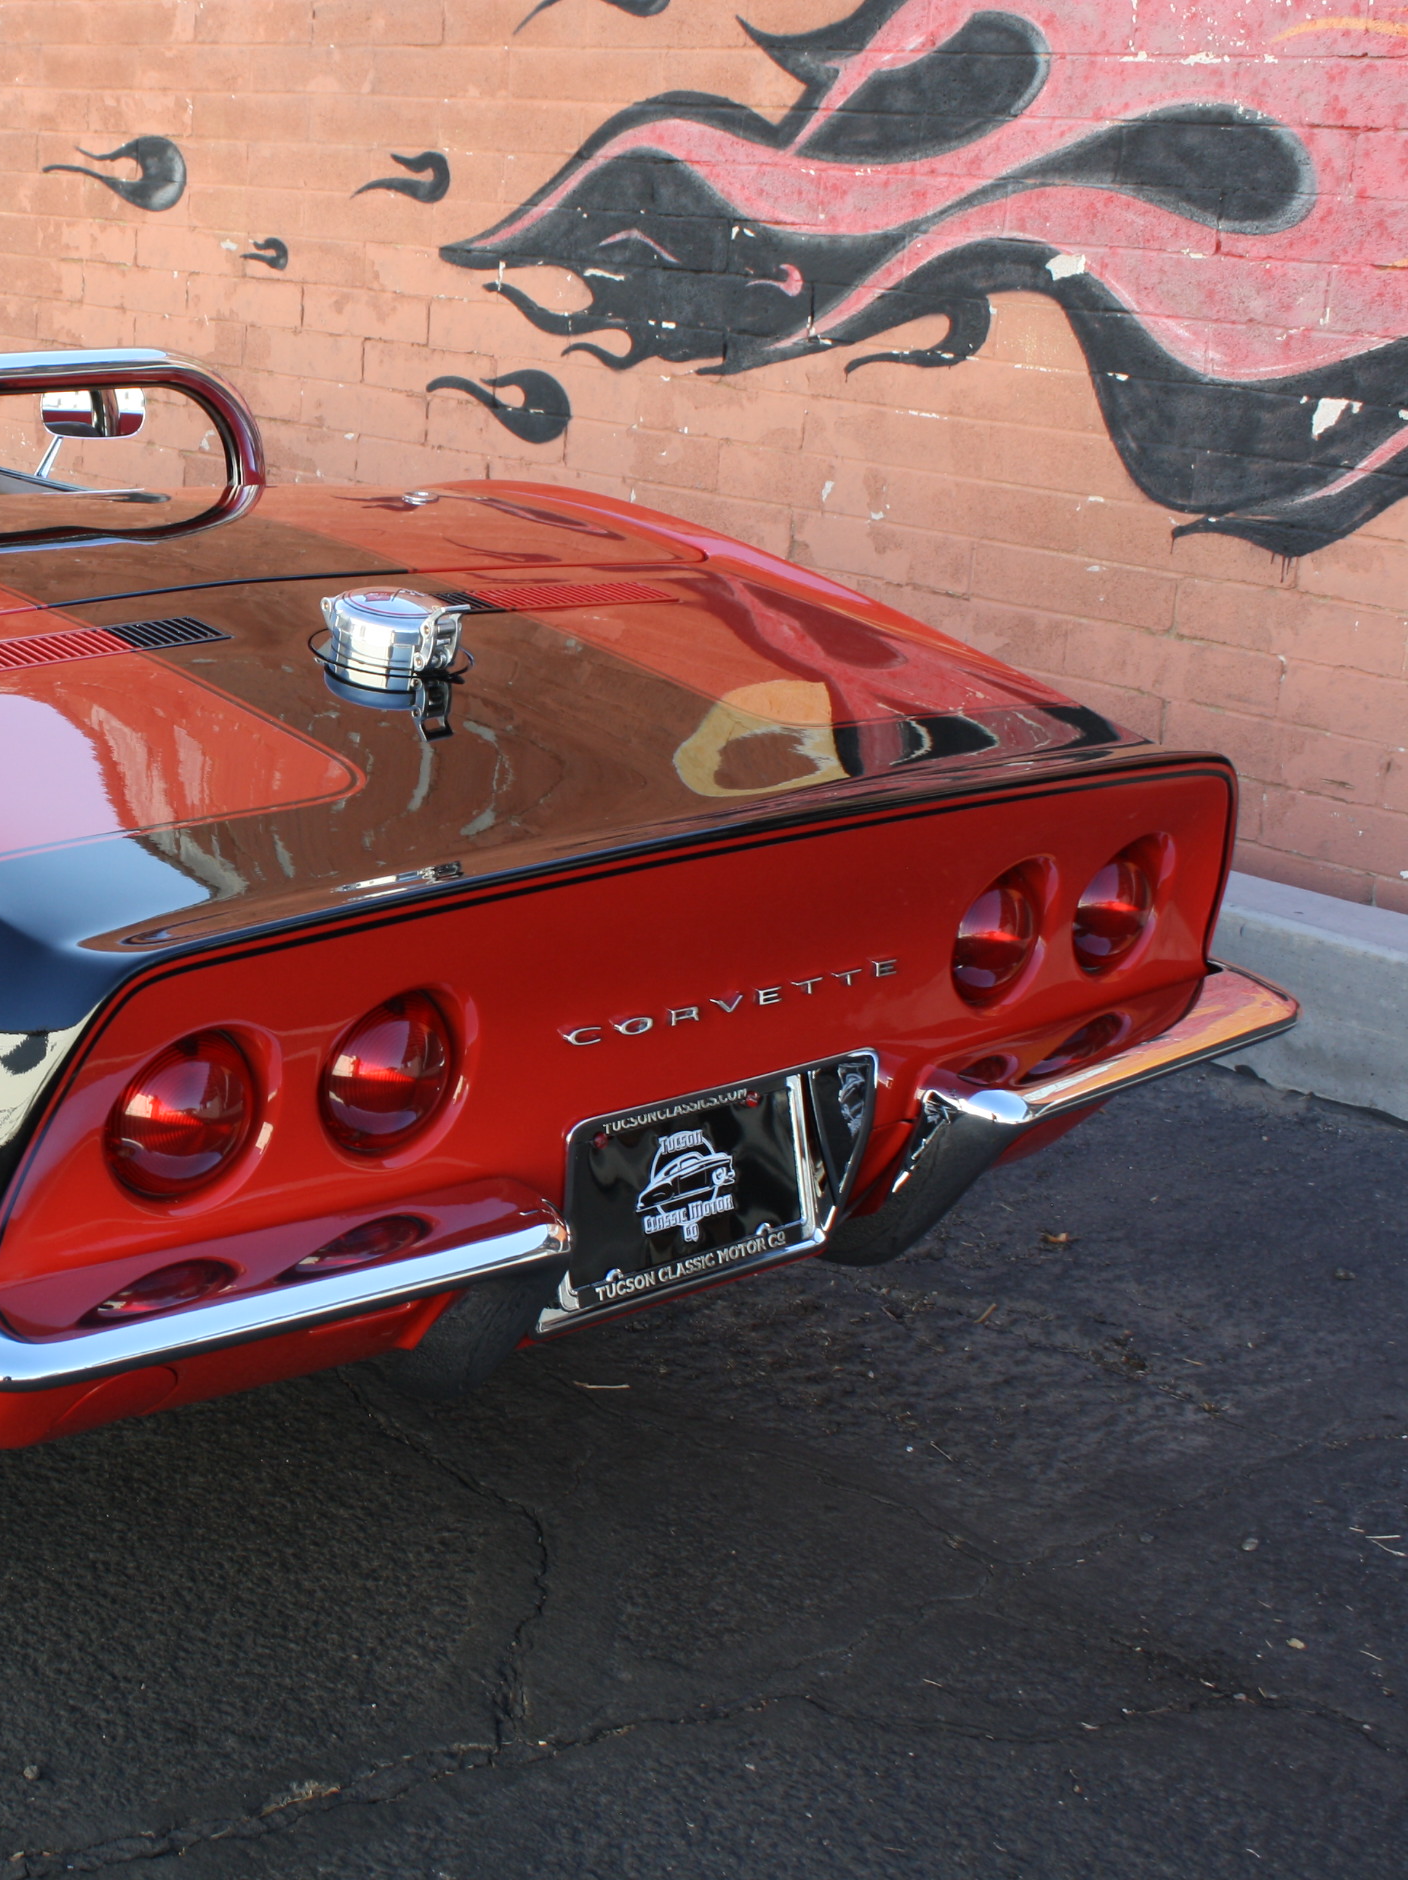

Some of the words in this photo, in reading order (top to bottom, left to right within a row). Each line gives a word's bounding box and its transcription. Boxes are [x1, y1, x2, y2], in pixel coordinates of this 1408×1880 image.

[560, 958, 898, 1046] CORVETTE
[595, 1272, 657, 1301] TUCSON
[658, 1252, 716, 1282] CLASSIC
[716, 1237, 767, 1264] MOTOR
